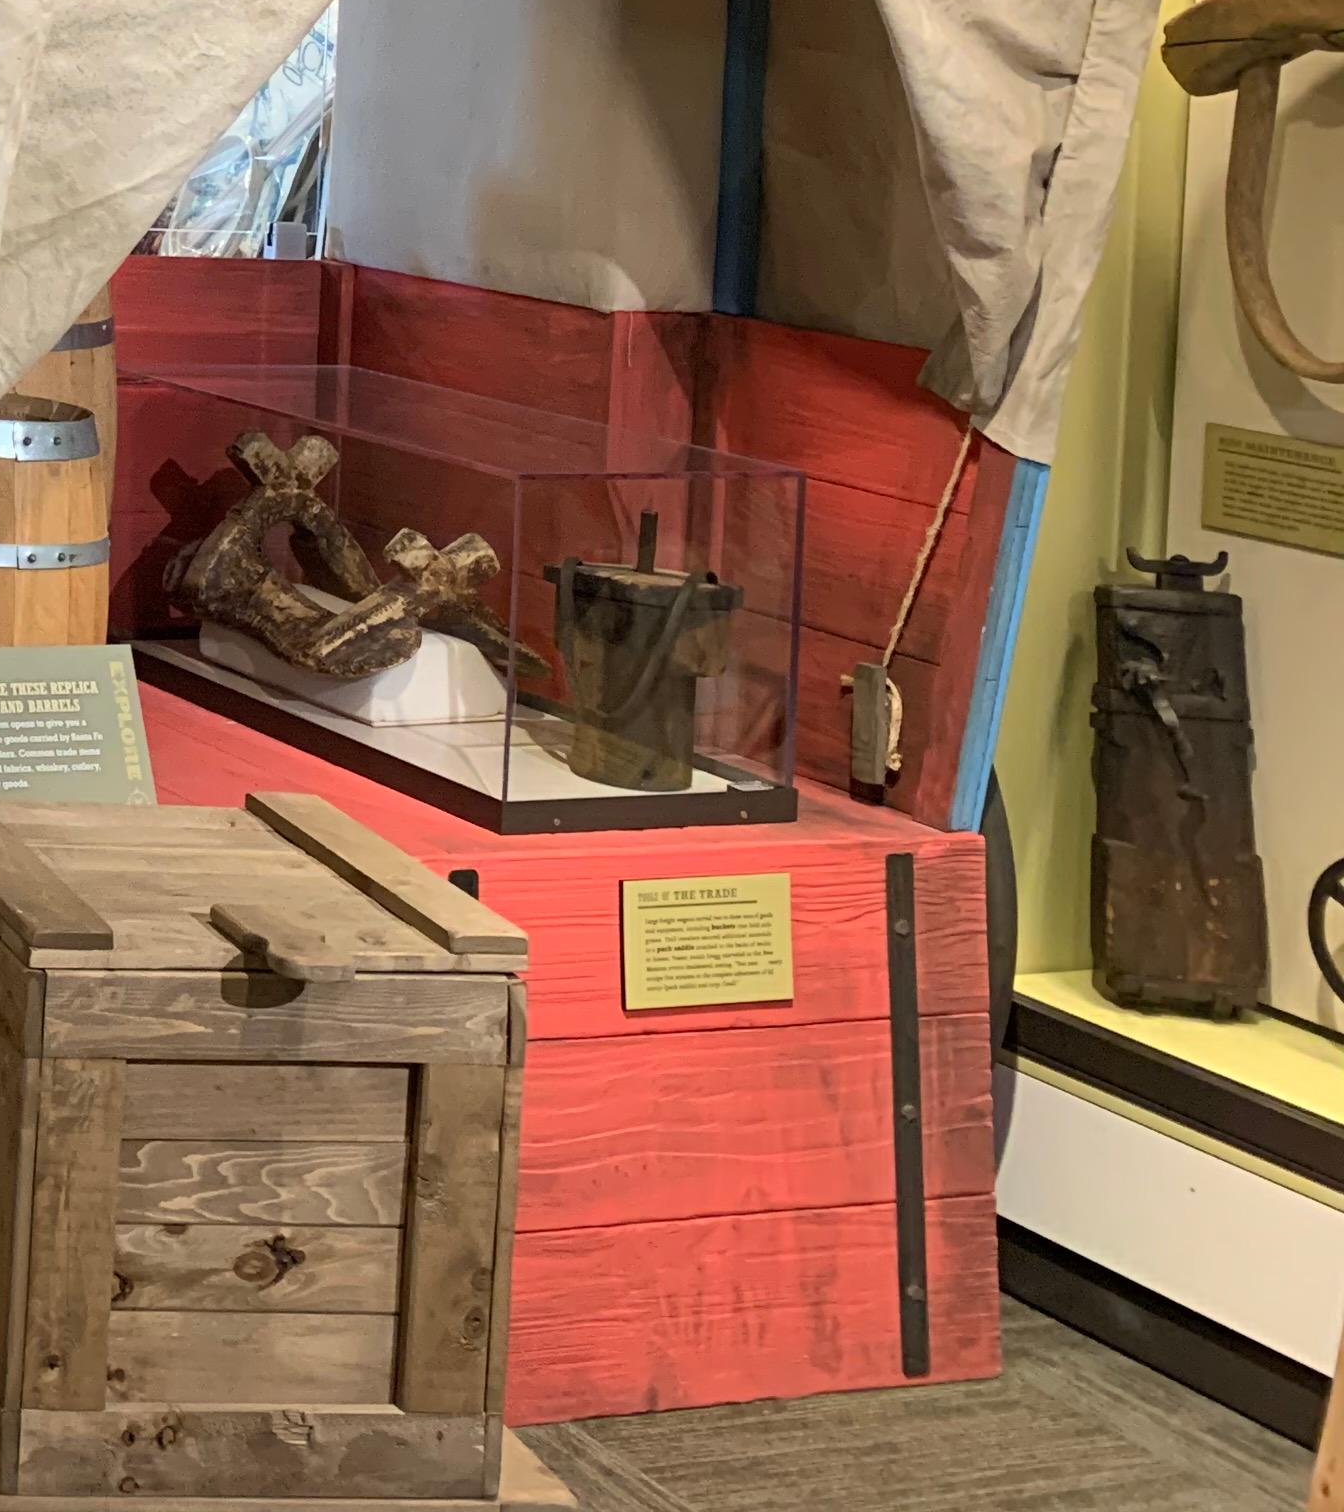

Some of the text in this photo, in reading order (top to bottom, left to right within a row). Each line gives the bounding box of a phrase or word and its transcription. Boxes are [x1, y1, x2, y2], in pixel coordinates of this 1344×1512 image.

[11, 682, 47, 696] THESE
[51, 681, 98, 695] REPLICA
[0, 701, 24, 713] AND
[29, 699, 80, 712] BARRELS
[673, 890, 696, 901] THE
[699, 888, 738, 900] TRADE
